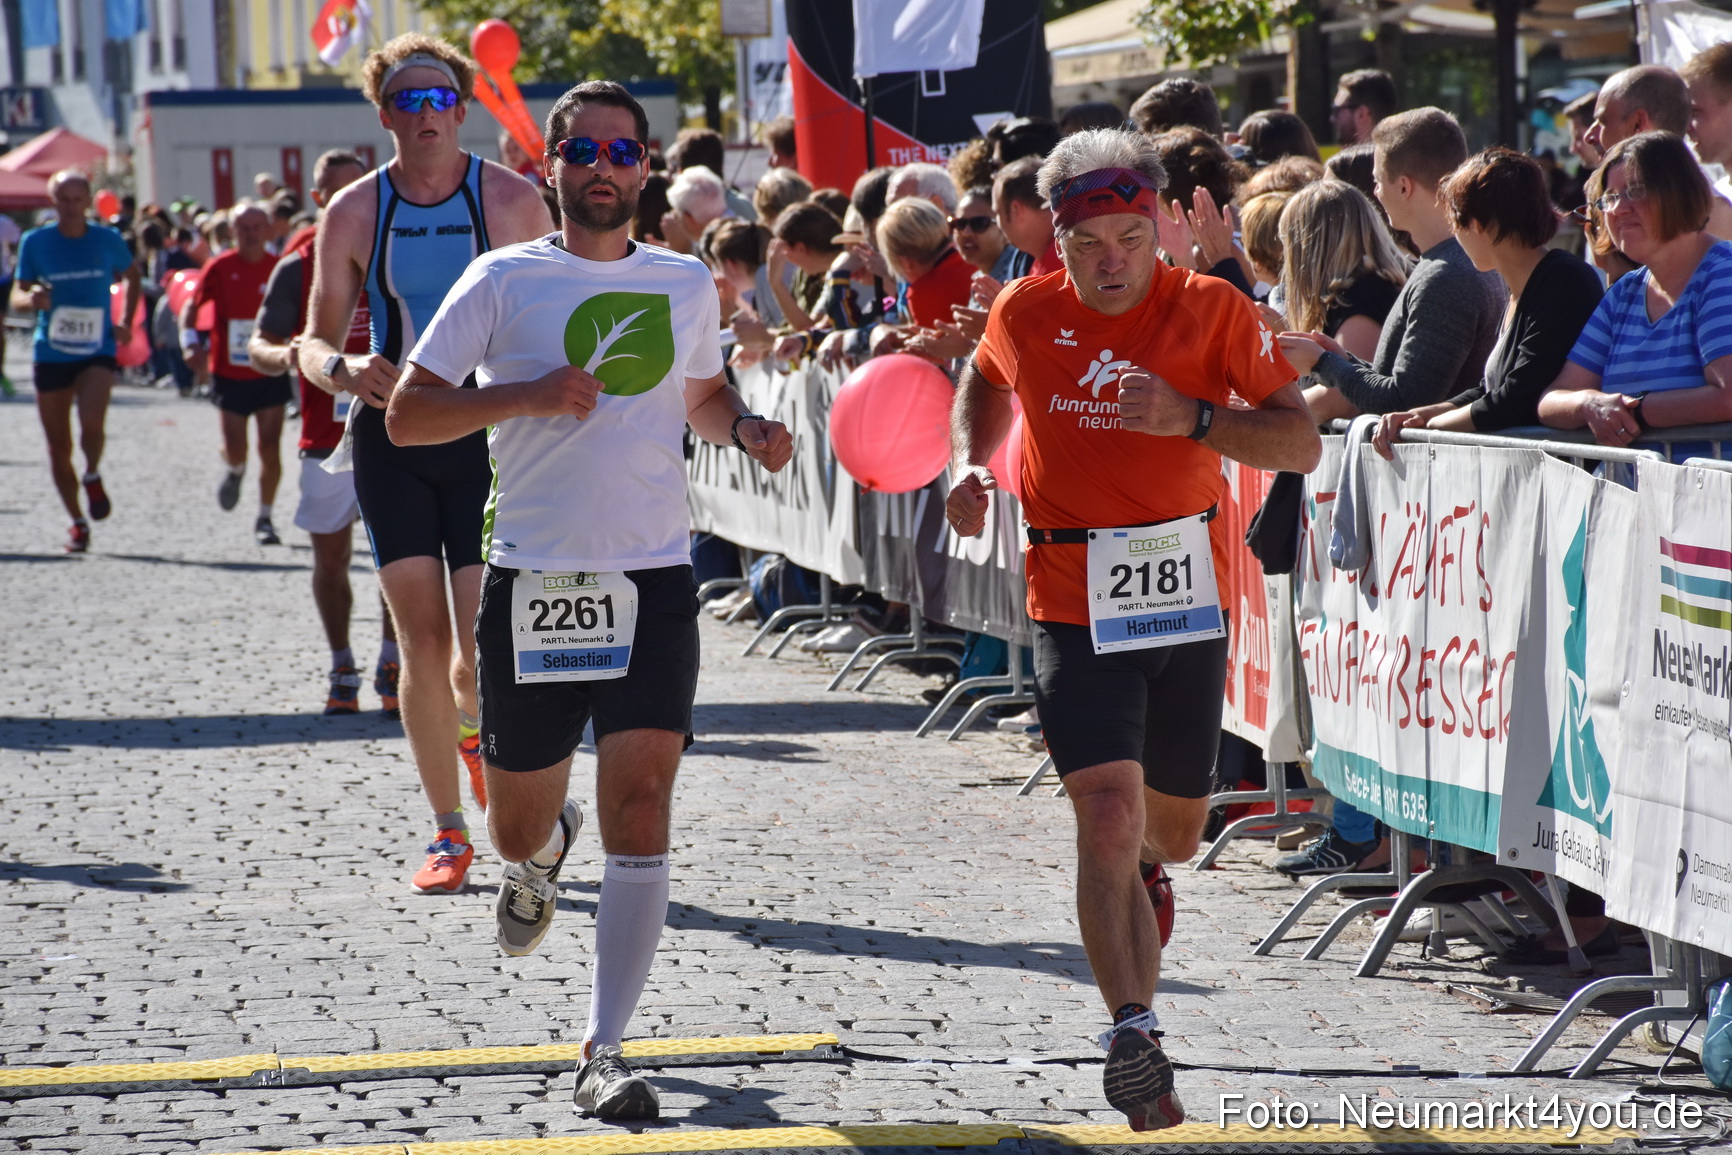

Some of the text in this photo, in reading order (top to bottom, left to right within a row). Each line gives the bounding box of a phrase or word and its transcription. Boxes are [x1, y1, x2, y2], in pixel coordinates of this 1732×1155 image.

[888, 142, 970, 165] THE NEXT
[58, 319, 94, 335] 2611
[1054, 338, 1078, 347] erima
[1128, 533, 1182, 553] BOCK
[543, 573, 599, 589] BOCK
[1109, 554, 1192, 599] 2181
[528, 594, 614, 632] 2261
[1118, 598, 1184, 612] PARTL Neumarkt
[1126, 614, 1189, 636] Hartmut
[541, 635, 604, 645] PARTL Neumarkt
[543, 652, 612, 669] Sebastian
[1532, 821, 1560, 853] Jura
